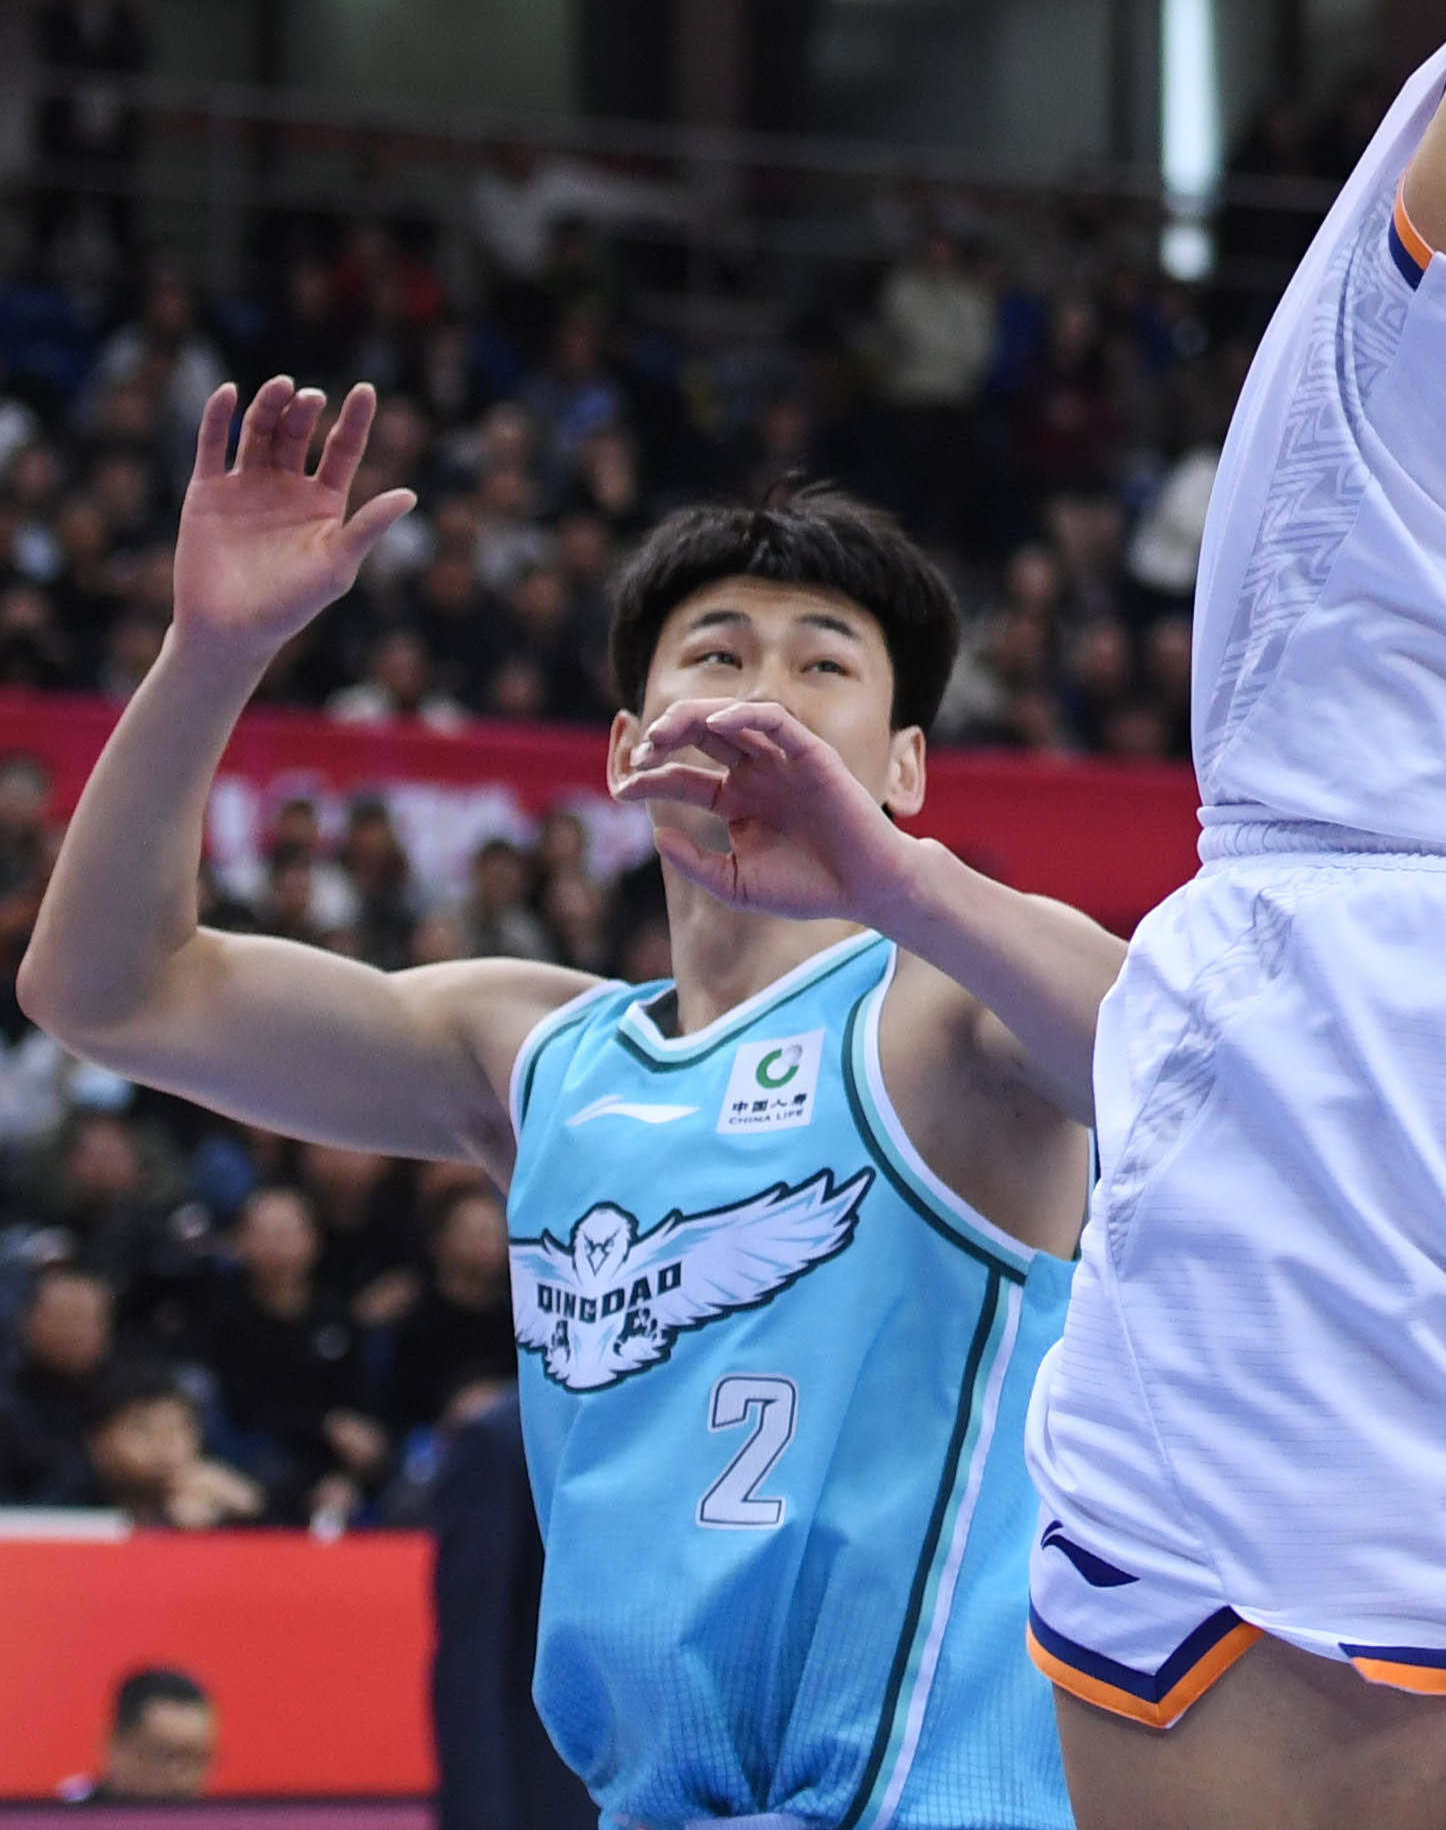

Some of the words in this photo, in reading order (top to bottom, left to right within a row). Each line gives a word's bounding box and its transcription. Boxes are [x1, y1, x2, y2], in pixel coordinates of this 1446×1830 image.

[728, 1115, 771, 1126] CHINA
[775, 1109, 804, 1122] LIFE
[731, 1092, 808, 1115] 中国人寿
[536, 1261, 683, 1325] QINGDAO
[696, 1371, 801, 1530] 2
